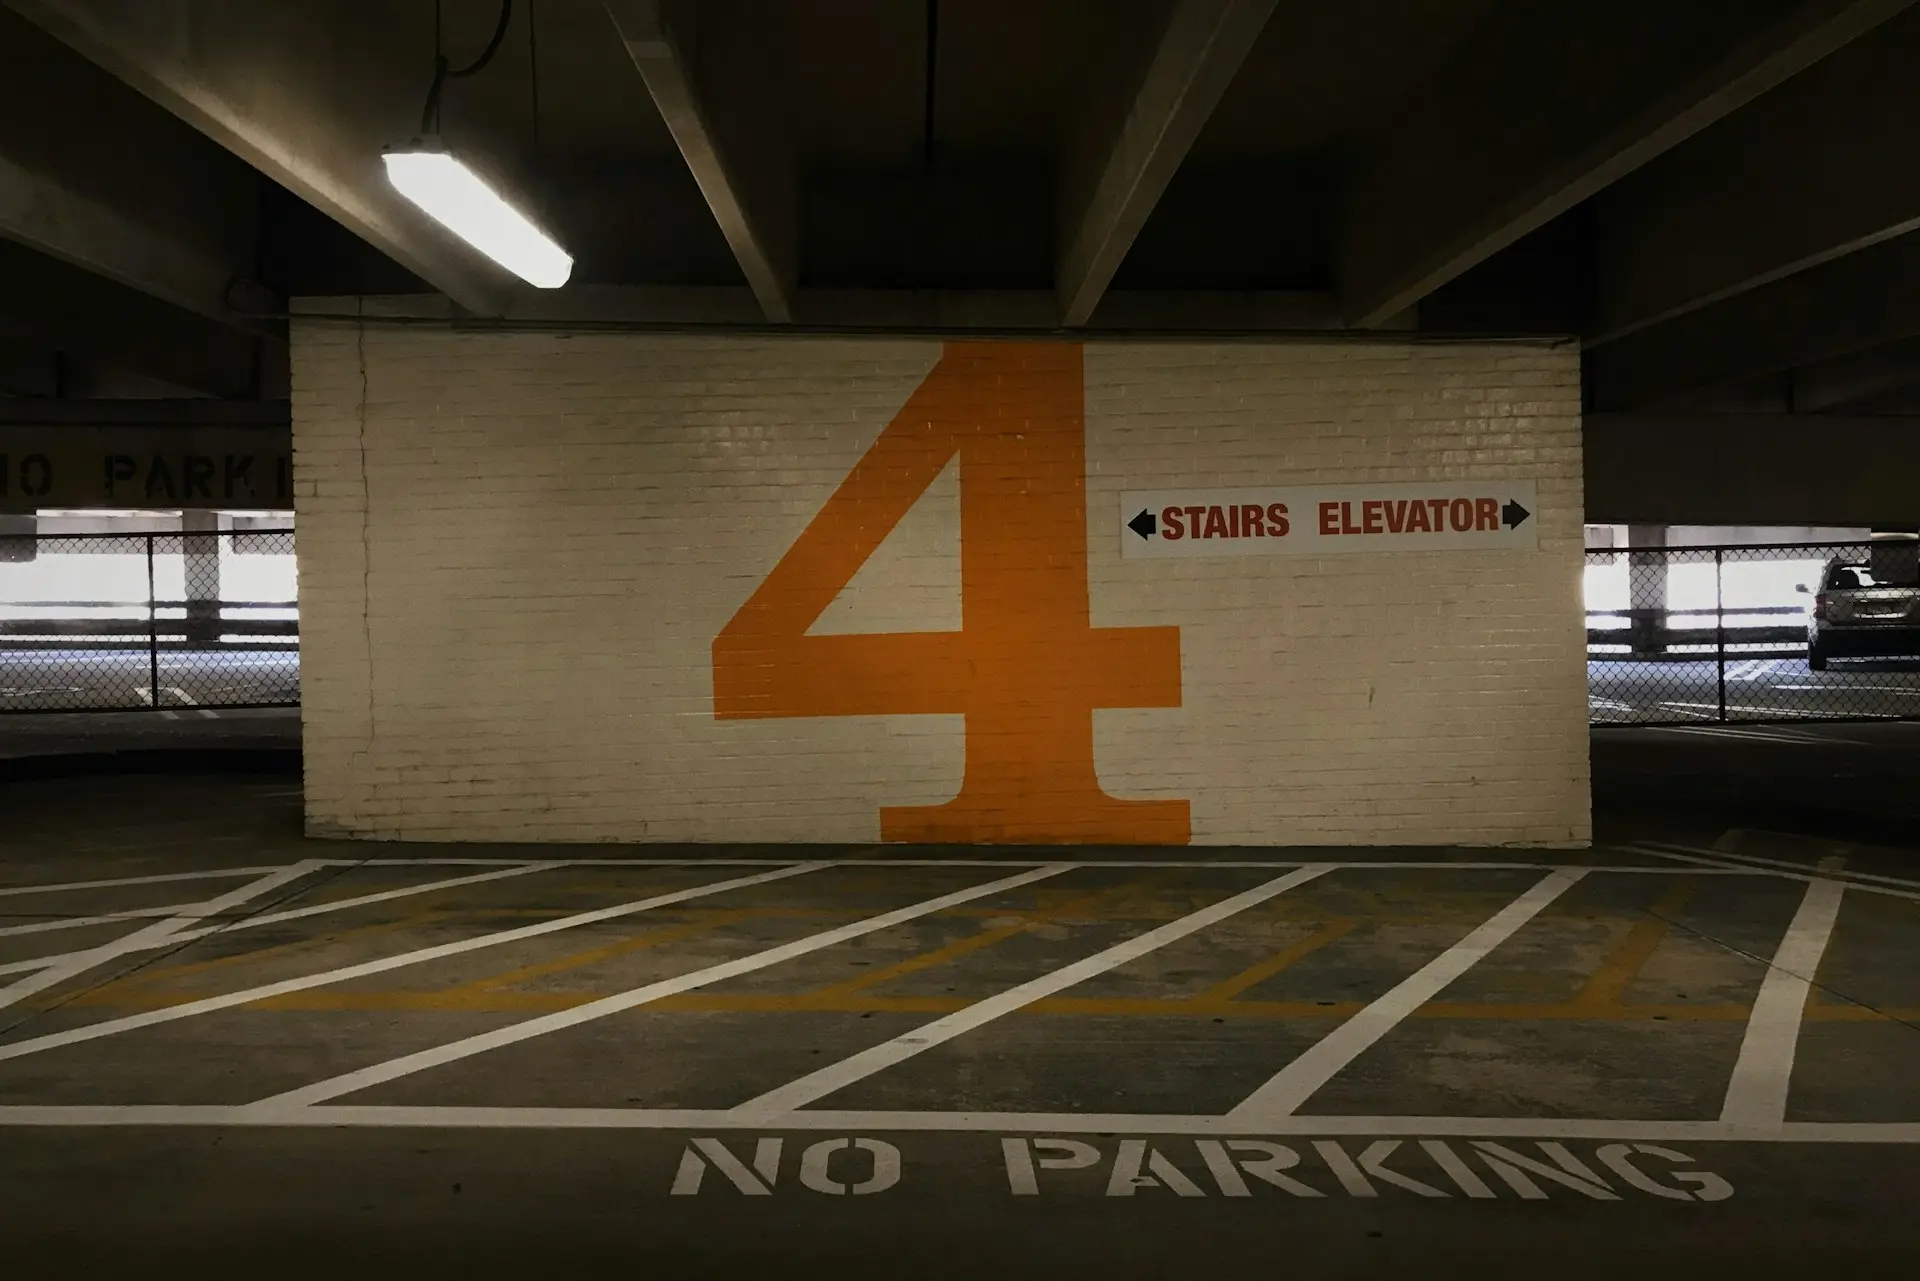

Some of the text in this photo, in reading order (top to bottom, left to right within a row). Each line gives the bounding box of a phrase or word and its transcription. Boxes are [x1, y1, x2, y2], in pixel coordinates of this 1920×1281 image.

[1161, 498, 1499, 541] STAIRS ELEVATOR
[712, 340, 1191, 846] 4
[670, 1137, 1735, 1202] NO PARKING
